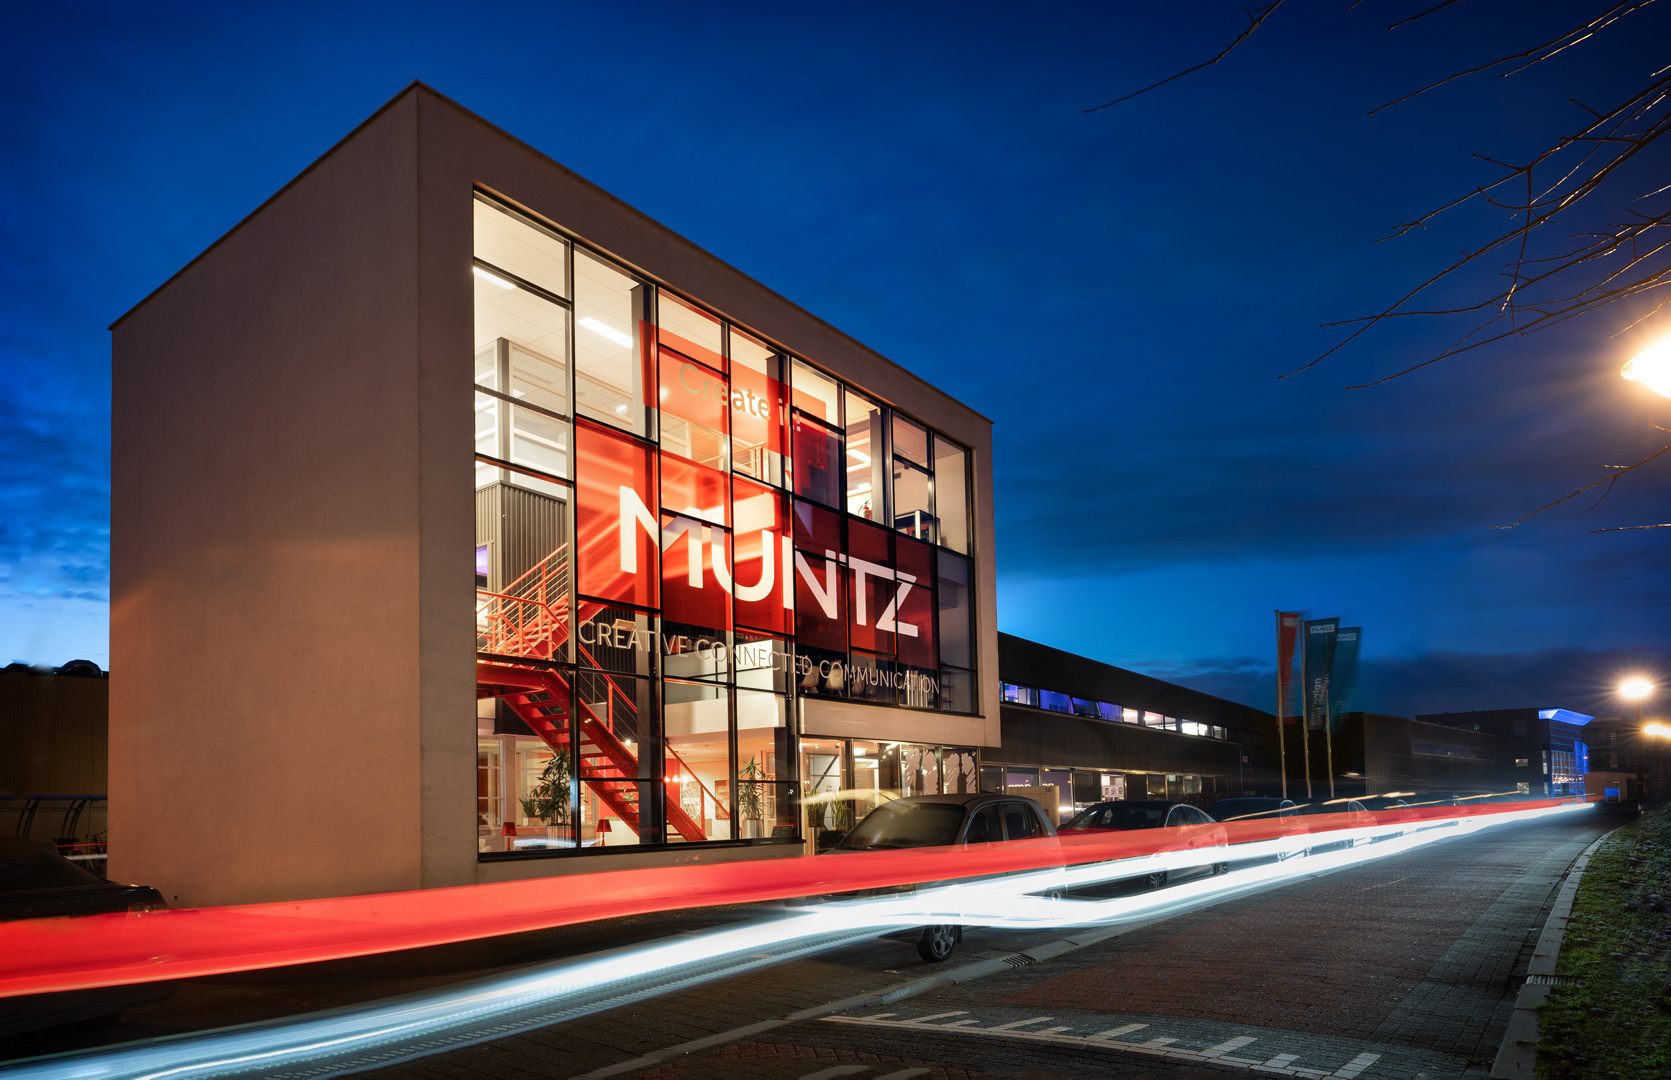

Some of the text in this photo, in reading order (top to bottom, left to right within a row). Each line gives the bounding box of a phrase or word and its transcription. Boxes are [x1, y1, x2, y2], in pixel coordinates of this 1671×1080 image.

[679, 362, 771, 421] Create
[619, 485, 919, 638] MUNTZ
[578, 620, 940, 694] CREATIVE CONNECTED COMMUNICATION
